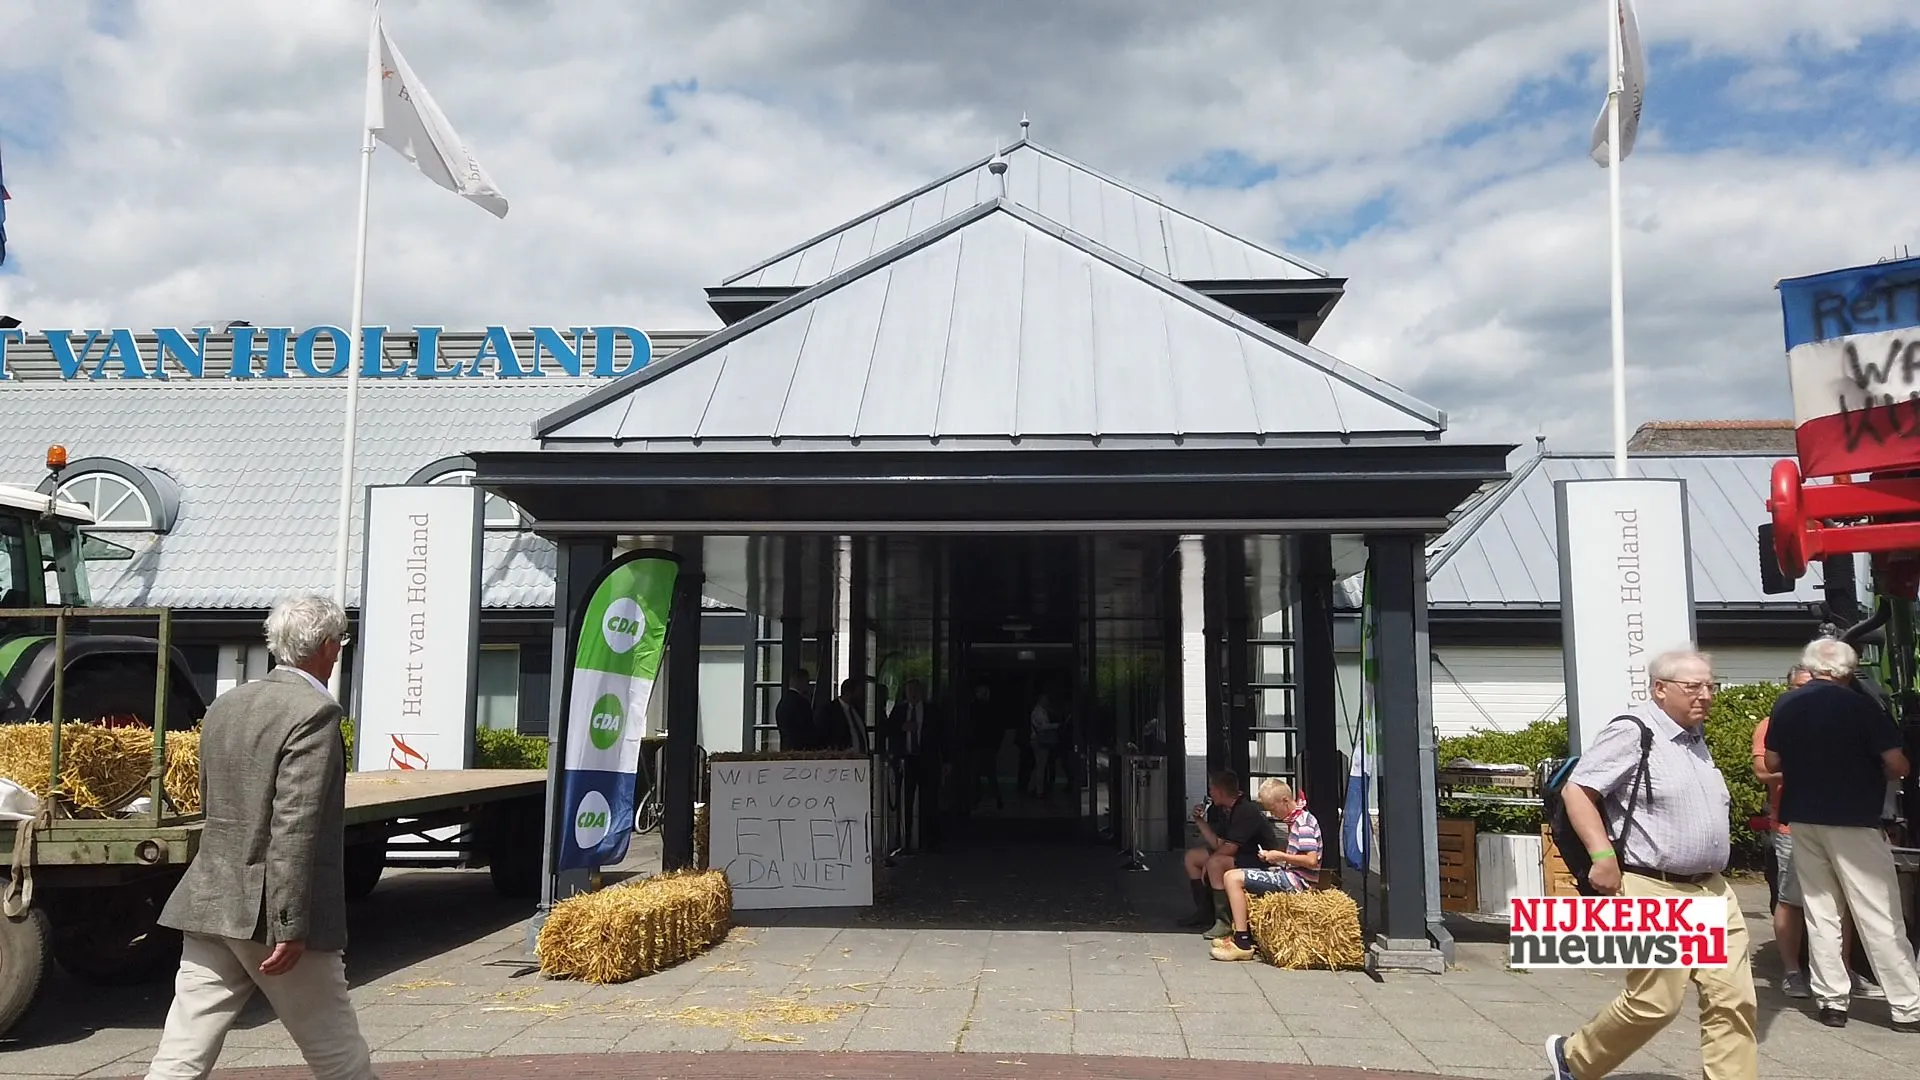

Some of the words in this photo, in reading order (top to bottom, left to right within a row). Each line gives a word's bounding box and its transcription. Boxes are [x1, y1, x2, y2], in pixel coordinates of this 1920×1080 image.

[40, 327, 214, 380] VAN
[225, 325, 654, 380] HOLLAND
[406, 512, 430, 604] Holland
[1615, 508, 1642, 605] Holland
[409, 611, 426, 656] van
[606, 616, 641, 637] CDA
[1626, 611, 1645, 657] van
[402, 663, 424, 717] Hart
[1626, 665, 1648, 710] art
[592, 712, 620, 732] CDA
[718, 768, 771, 785] WIE
[576, 812, 608, 829] CDA
[769, 793, 837, 818] VOOR
[724, 858, 782, 888] CDA
[793, 861, 852, 884] NIET
